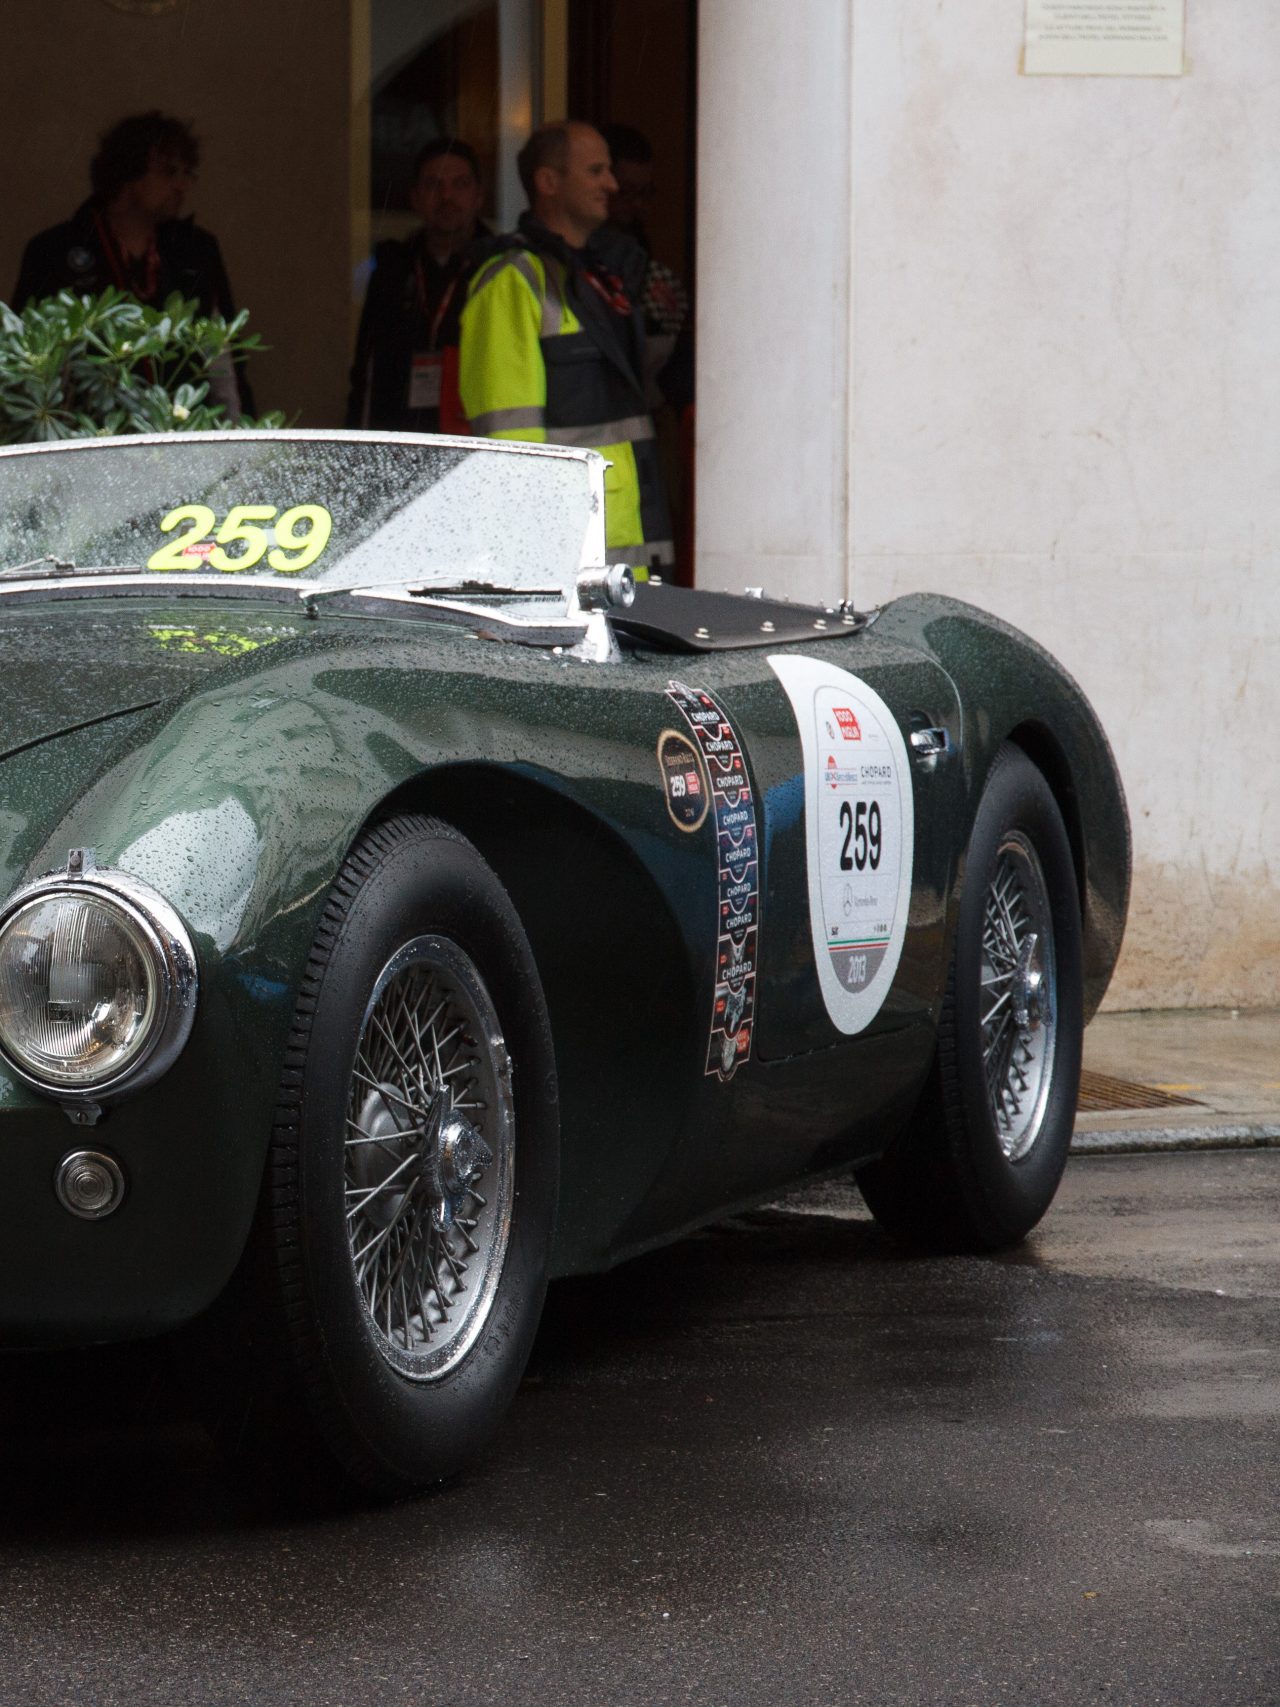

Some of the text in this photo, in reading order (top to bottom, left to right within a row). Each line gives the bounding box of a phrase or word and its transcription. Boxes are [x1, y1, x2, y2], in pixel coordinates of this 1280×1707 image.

[147, 504, 332, 572] 259
[691, 711, 720, 723] CHOPARD
[705, 740, 734, 752] CHOPARD
[860, 765, 892, 778] CHOPARD
[670, 774, 686, 797] 259
[716, 774, 744, 788] CHOPARD
[723, 810, 749, 826] CHOPARD
[839, 800, 882, 871] 259
[725, 847, 752, 863] CHOPARD
[726, 882, 752, 898] CHOPARD
[726, 912, 752, 930] CHOPARD
[722, 961, 752, 980] CHOPARD
[847, 954, 867, 984] 2013
